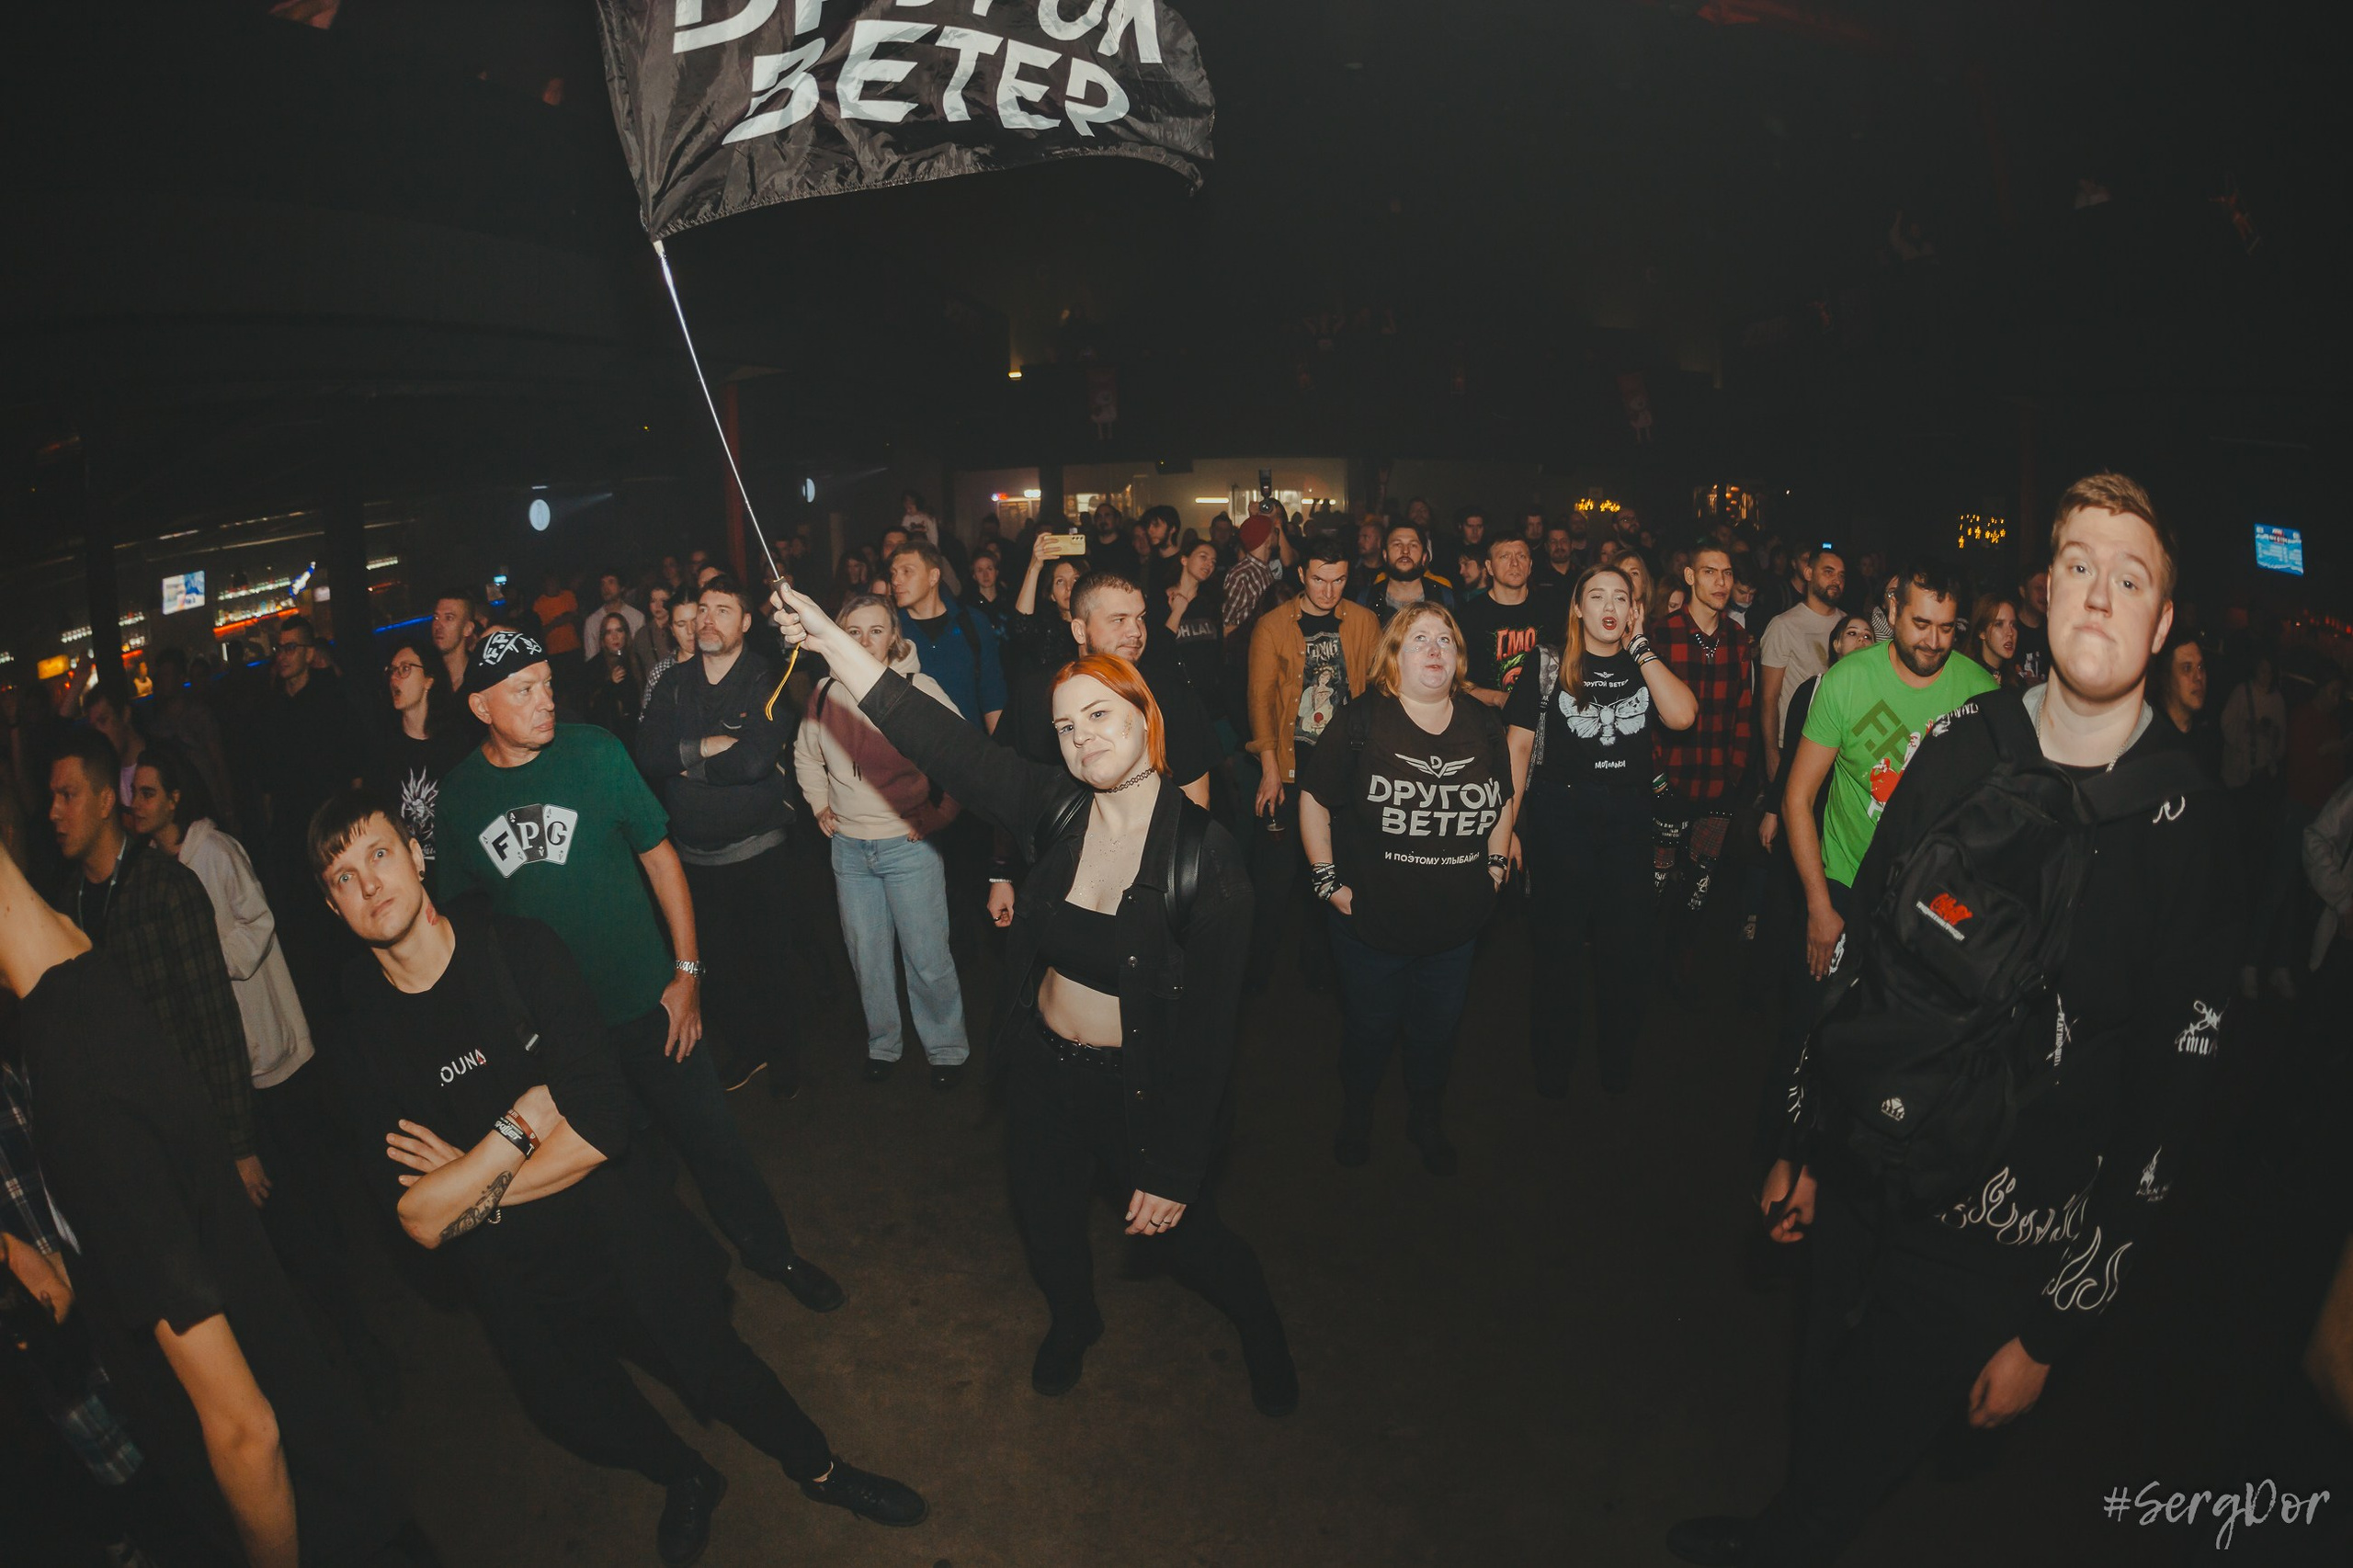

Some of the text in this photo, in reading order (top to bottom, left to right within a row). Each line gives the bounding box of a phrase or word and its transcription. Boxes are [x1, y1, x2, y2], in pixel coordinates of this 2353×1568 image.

[722, 19, 1130, 145] ВЕТЕР
[1381, 806, 1497, 836] ВЕТЕР
[1384, 851, 1392, 860] И
[1393, 853, 1440, 865] ПОЭТОМУ
